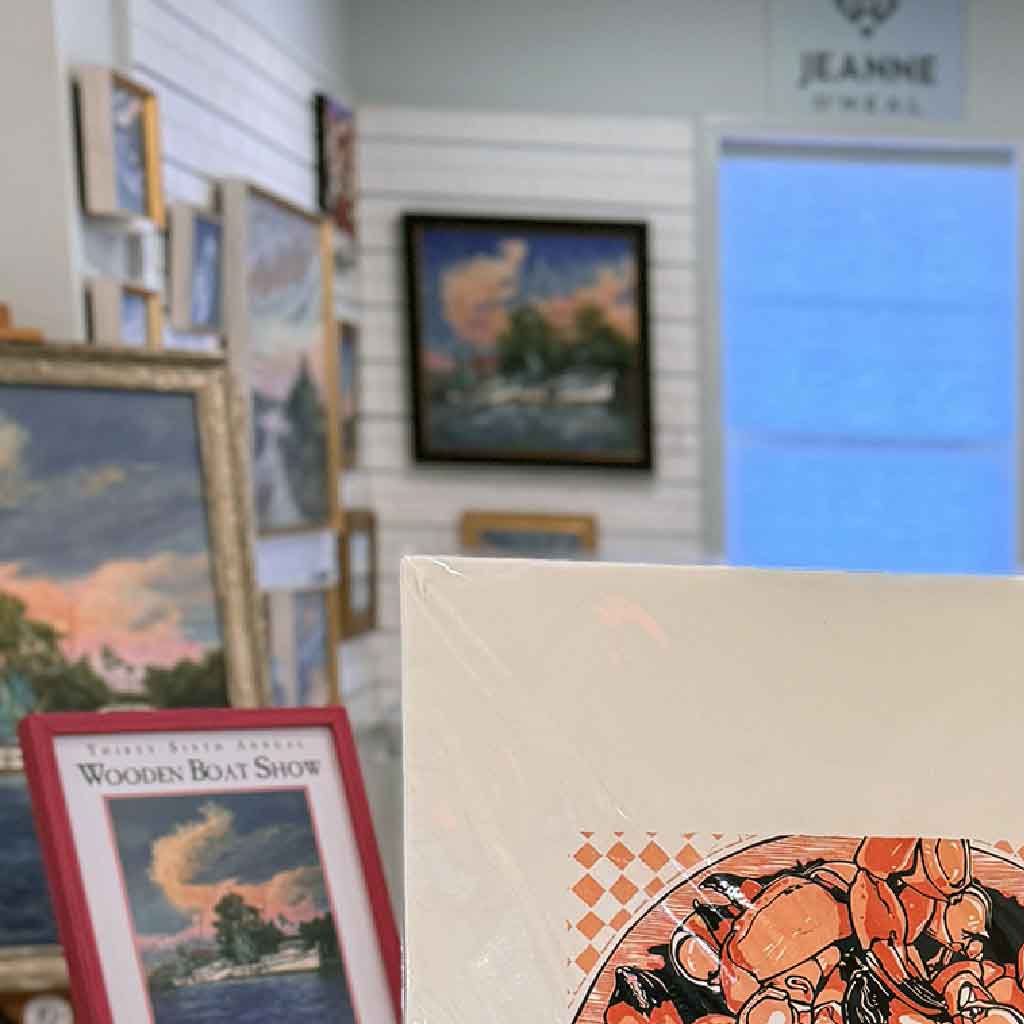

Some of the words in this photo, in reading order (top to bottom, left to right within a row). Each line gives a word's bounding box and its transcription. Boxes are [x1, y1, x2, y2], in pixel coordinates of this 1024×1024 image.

[799, 51, 937, 88] JEANNE
[77, 761, 184, 787] WOODEN
[187, 757, 249, 783] BOAT
[253, 754, 321, 780] SHOW
